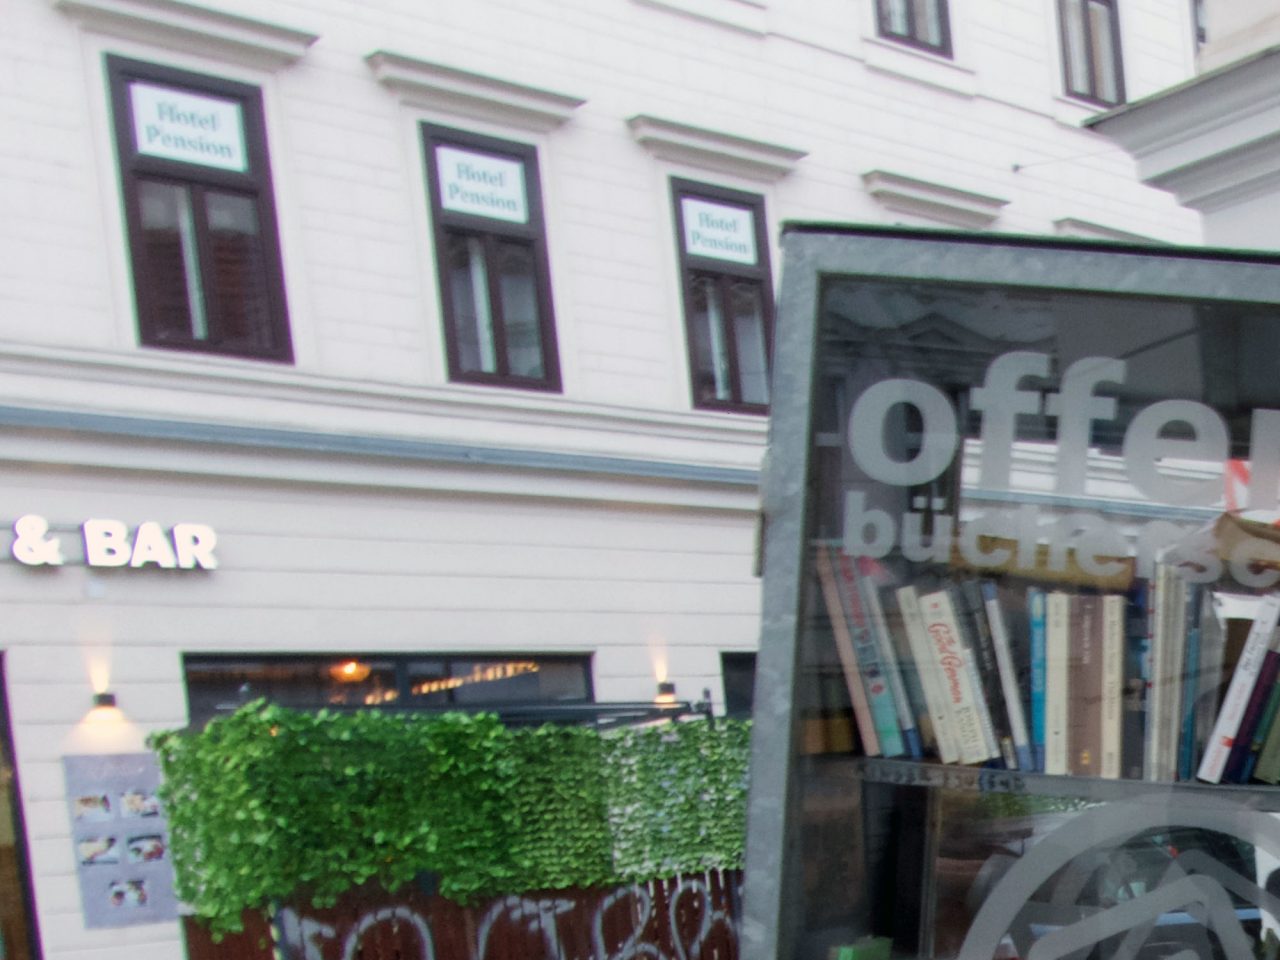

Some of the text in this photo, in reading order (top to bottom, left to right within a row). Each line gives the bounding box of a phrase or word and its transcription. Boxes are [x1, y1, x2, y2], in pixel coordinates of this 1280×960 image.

[156, 101, 217, 131] Hotel
[145, 124, 232, 158] Pension
[456, 162, 503, 188] Hotel
[448, 182, 517, 212] Pension
[698, 212, 737, 233] Hotel
[691, 230, 747, 254] Pension
[12, 514, 218, 569] & BAR
